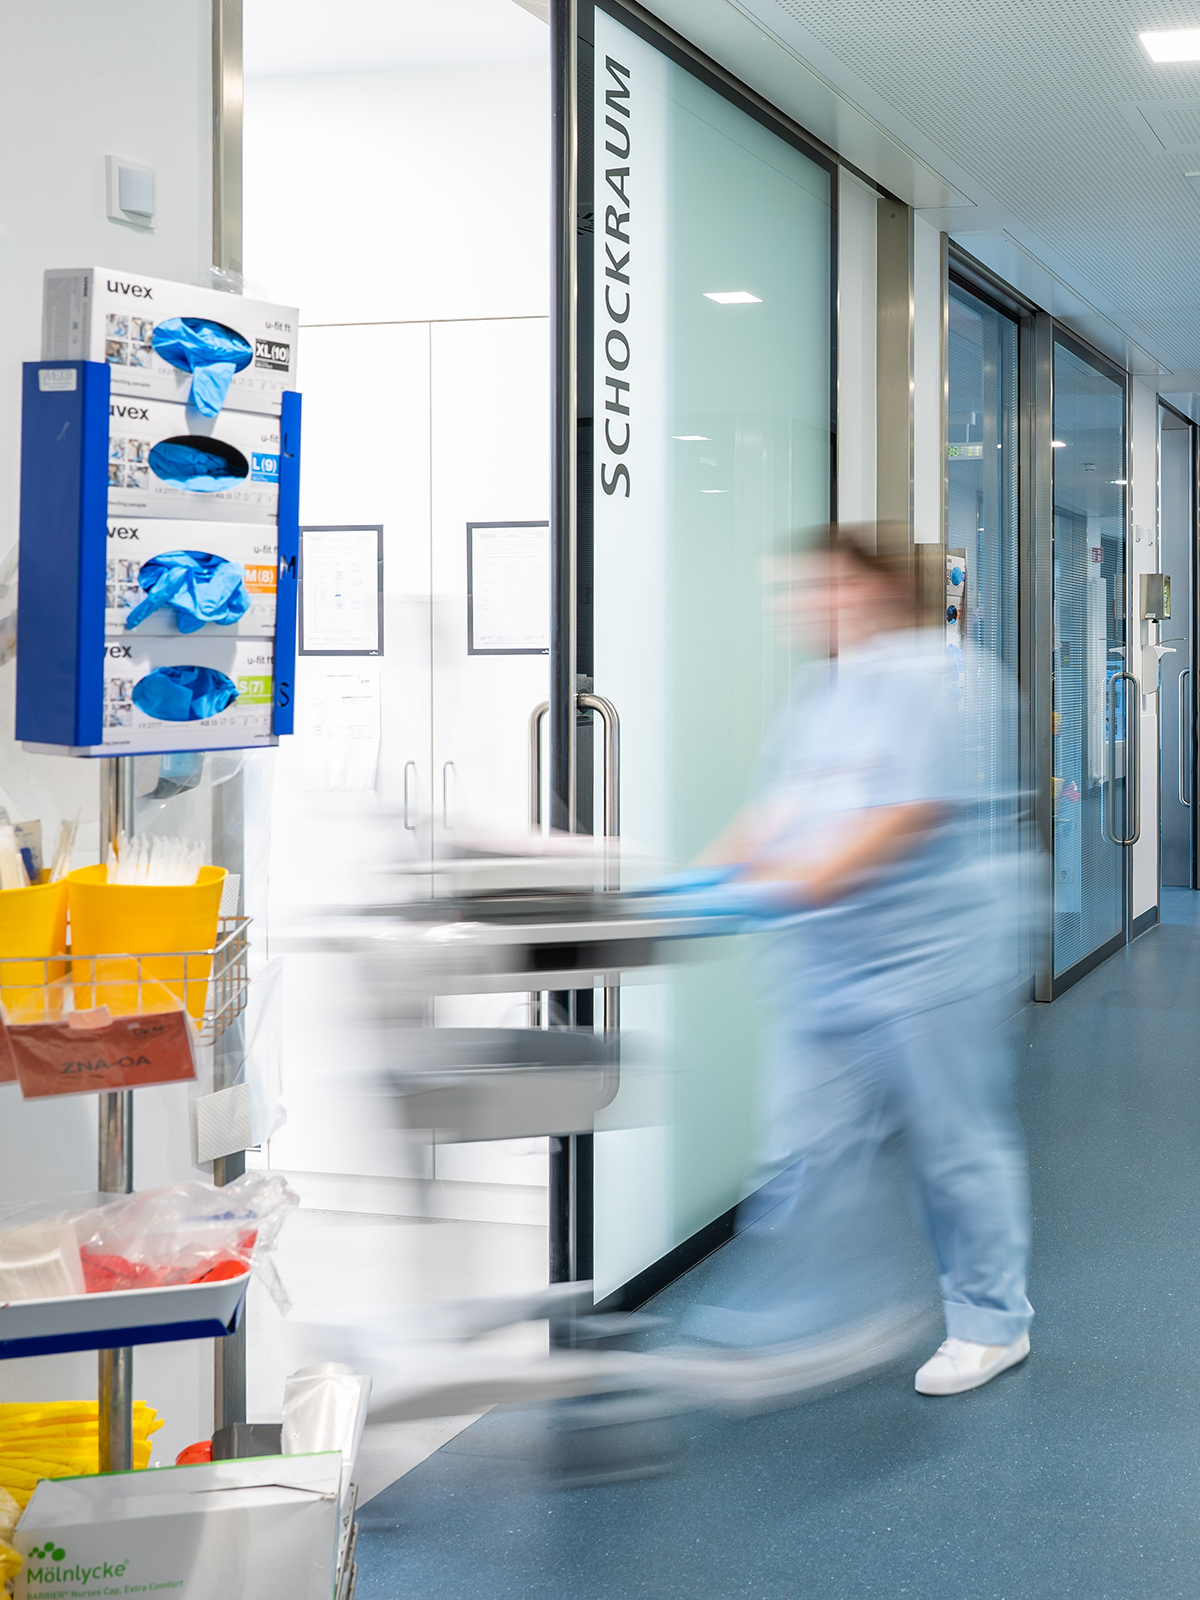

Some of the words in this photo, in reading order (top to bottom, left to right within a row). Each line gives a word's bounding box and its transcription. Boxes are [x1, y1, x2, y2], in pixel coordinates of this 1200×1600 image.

[600, 55, 631, 498] SCHOCKRAUM
[106, 280, 154, 300] uvex
[284, 432, 295, 458] L
[106, 525, 140, 541] vex
[280, 555, 297, 580] M
[277, 682, 290, 707] S
[61, 1055, 151, 1075] ZNA-OA
[71, 1587, 102, 1598] Nurses
[124, 1583, 147, 1593] Extra
[149, 1579, 184, 1590] Comfort
